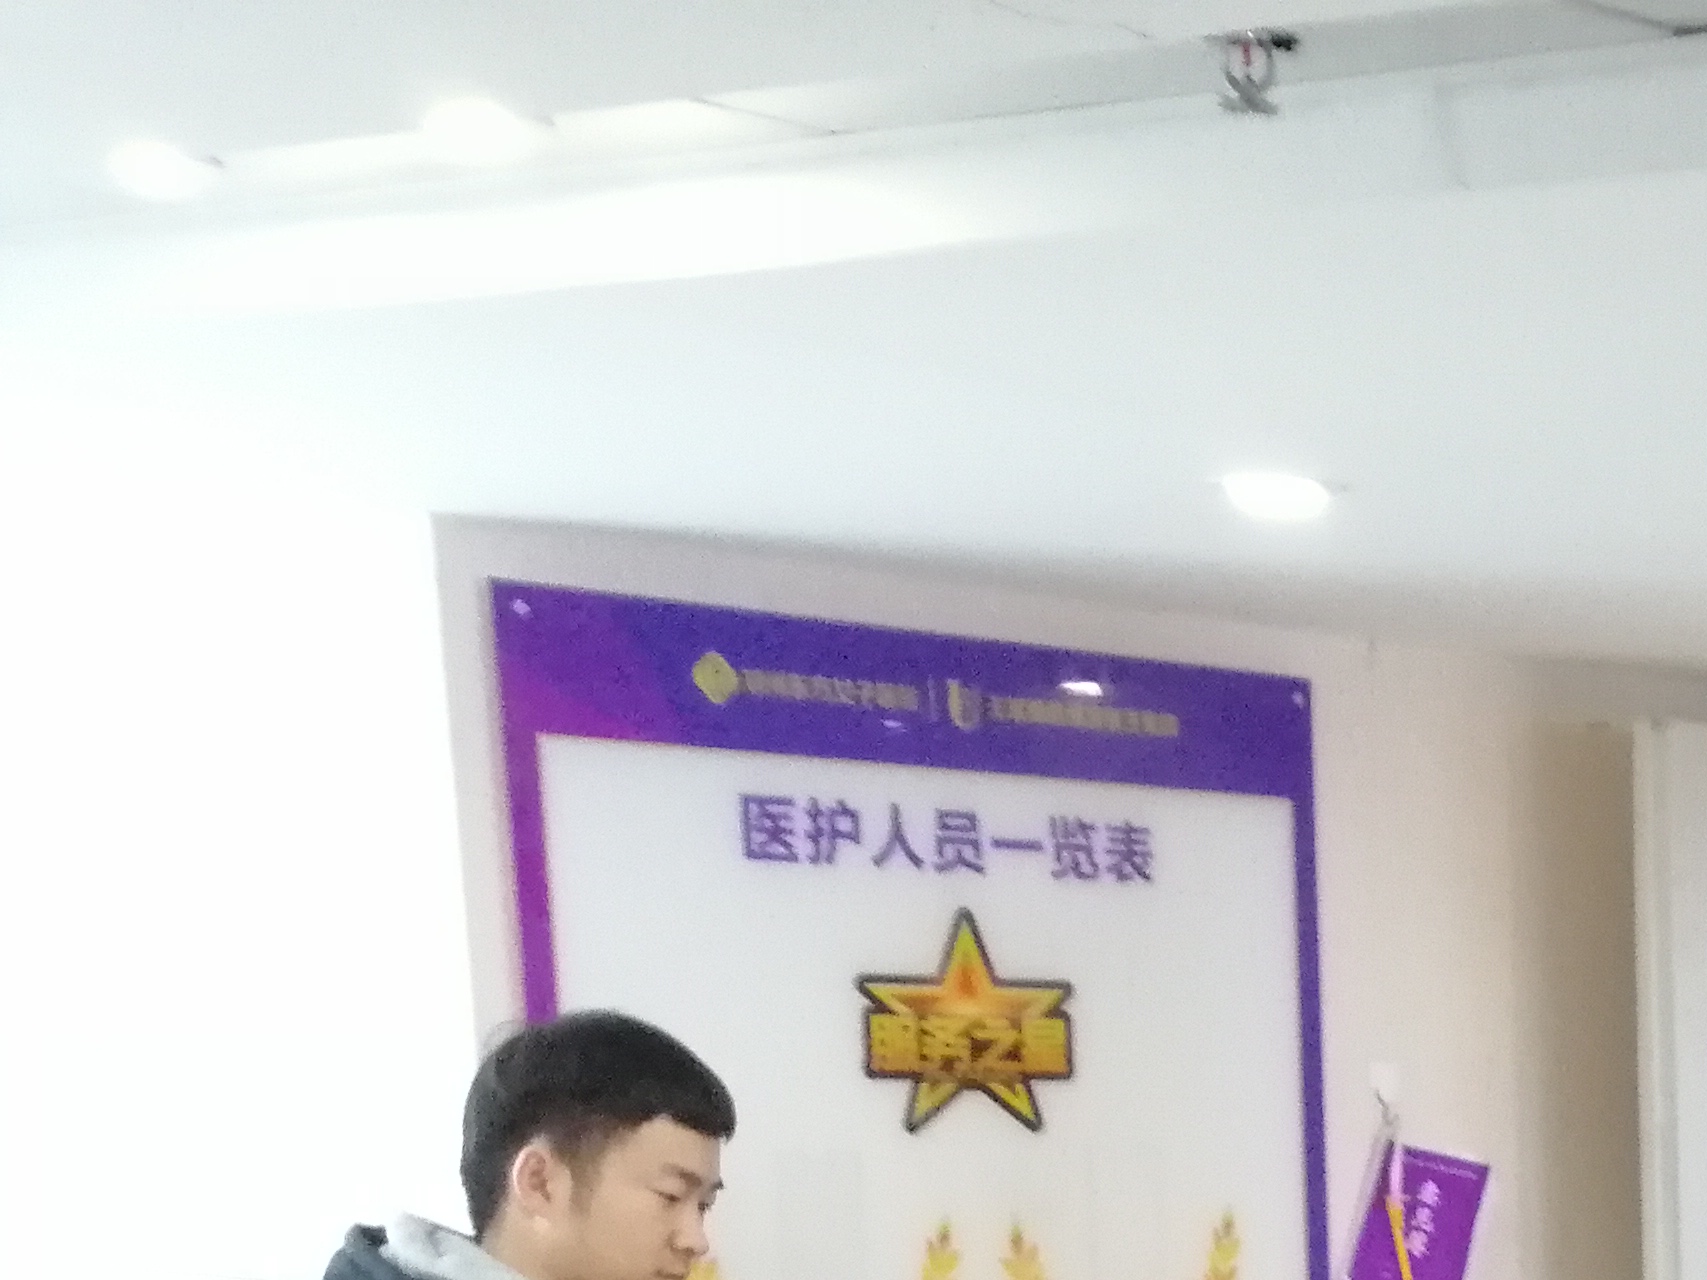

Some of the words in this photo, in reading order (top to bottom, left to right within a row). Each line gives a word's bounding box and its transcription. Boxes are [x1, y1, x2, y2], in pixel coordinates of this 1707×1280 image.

[739, 793, 1154, 883] 医护人员一览表
[869, 1013, 1068, 1073] 服务之星
